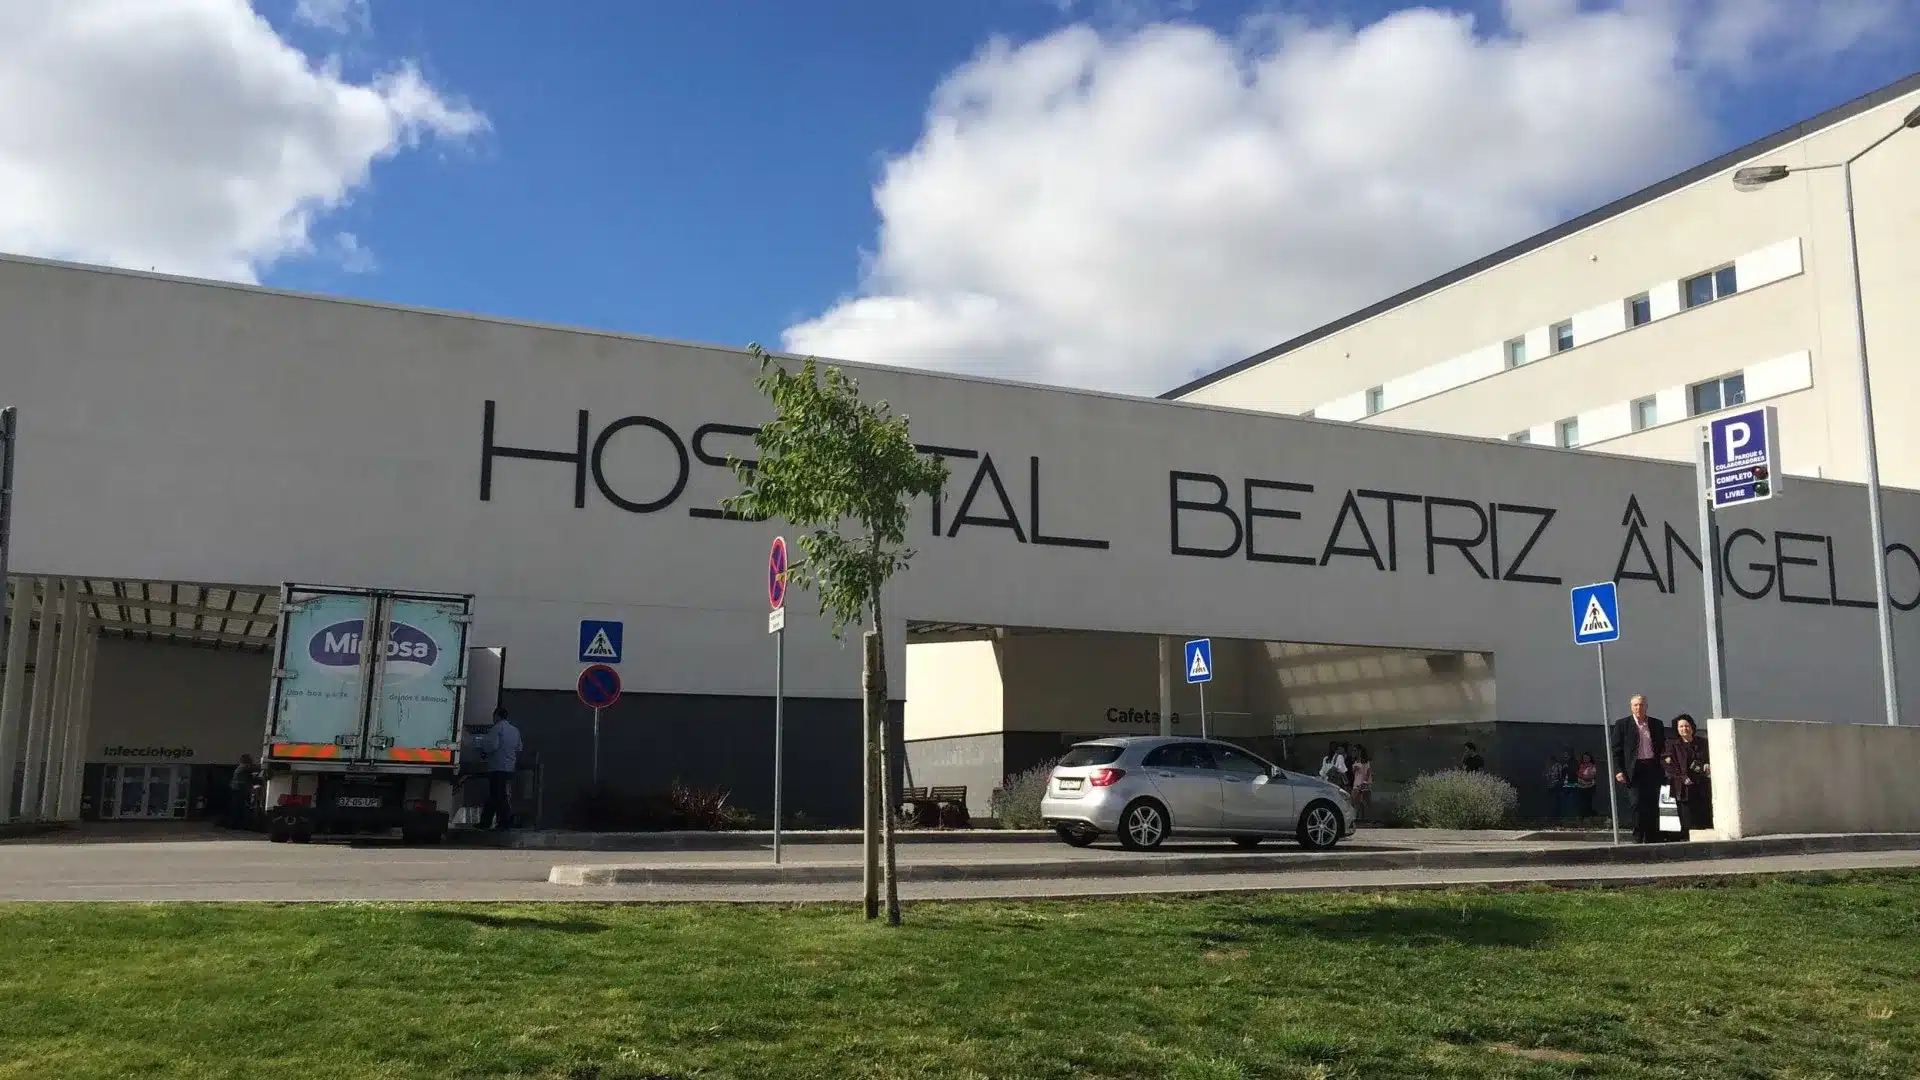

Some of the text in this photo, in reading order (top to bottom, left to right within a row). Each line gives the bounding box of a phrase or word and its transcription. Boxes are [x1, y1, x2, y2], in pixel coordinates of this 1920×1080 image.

[1725, 422, 1750, 462] P
[1715, 455, 1765, 471] COLABORADORES
[1734, 451, 1757, 460] PARQUE
[1716, 472, 1752, 484] COMPLETO
[480, 400, 1110, 549] HOSTAL
[1170, 470, 1562, 584] BEATRIZ
[1725, 489, 1745, 499] LIVRE
[1106, 707, 1180, 724] Cafetaa
[104, 745, 194, 759] Infecciologia
